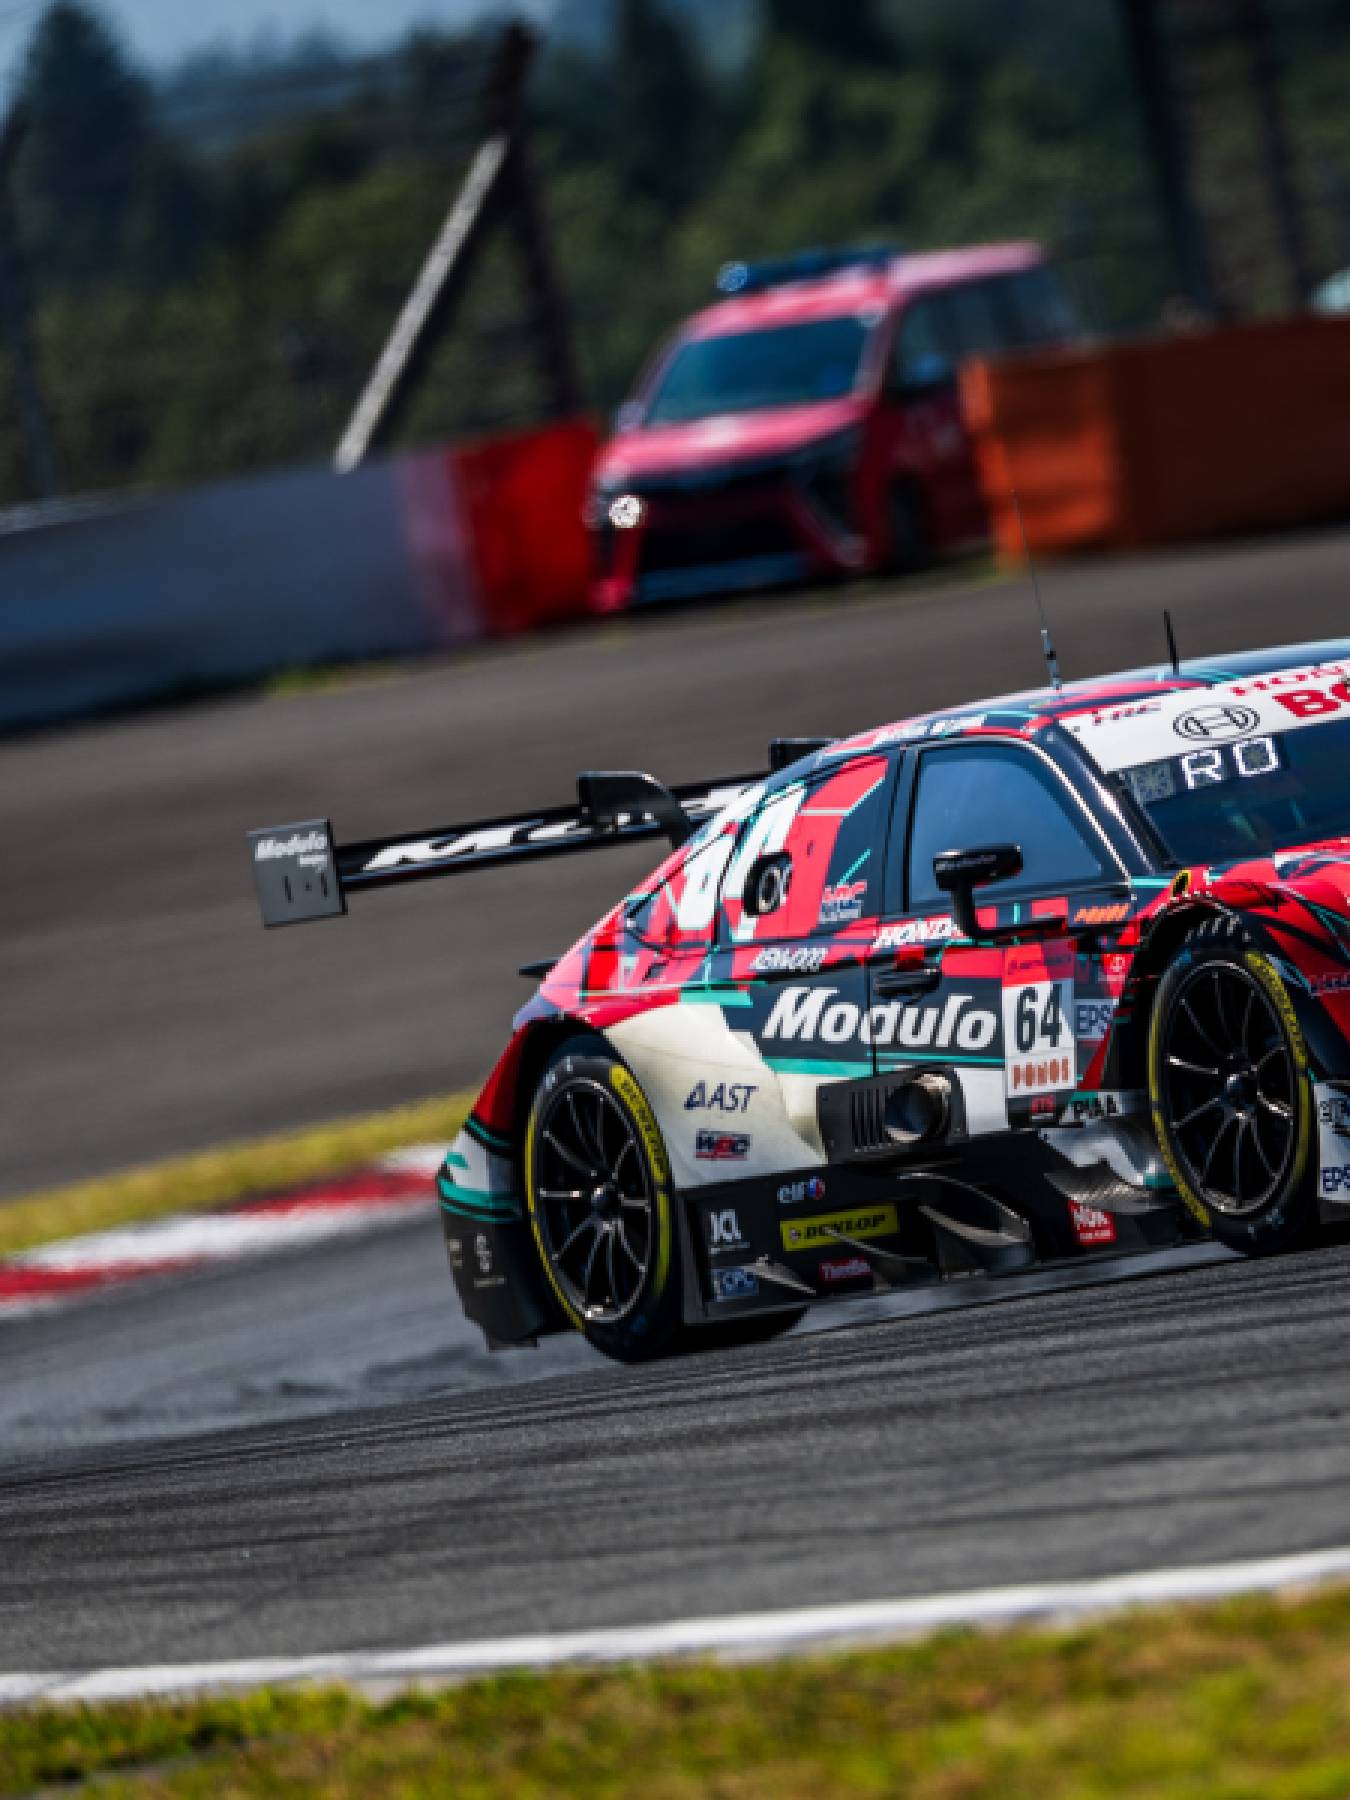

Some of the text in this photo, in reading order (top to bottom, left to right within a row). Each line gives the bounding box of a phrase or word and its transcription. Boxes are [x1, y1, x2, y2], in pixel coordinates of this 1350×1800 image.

[254, 832, 329, 862] Modulo
[761, 986, 998, 1050] Modulo
[1015, 983, 1064, 1053] 64
[1011, 1055, 1070, 1090] PONOS
[707, 1083, 760, 1112] AST
[803, 1213, 887, 1240] DUNLOP
